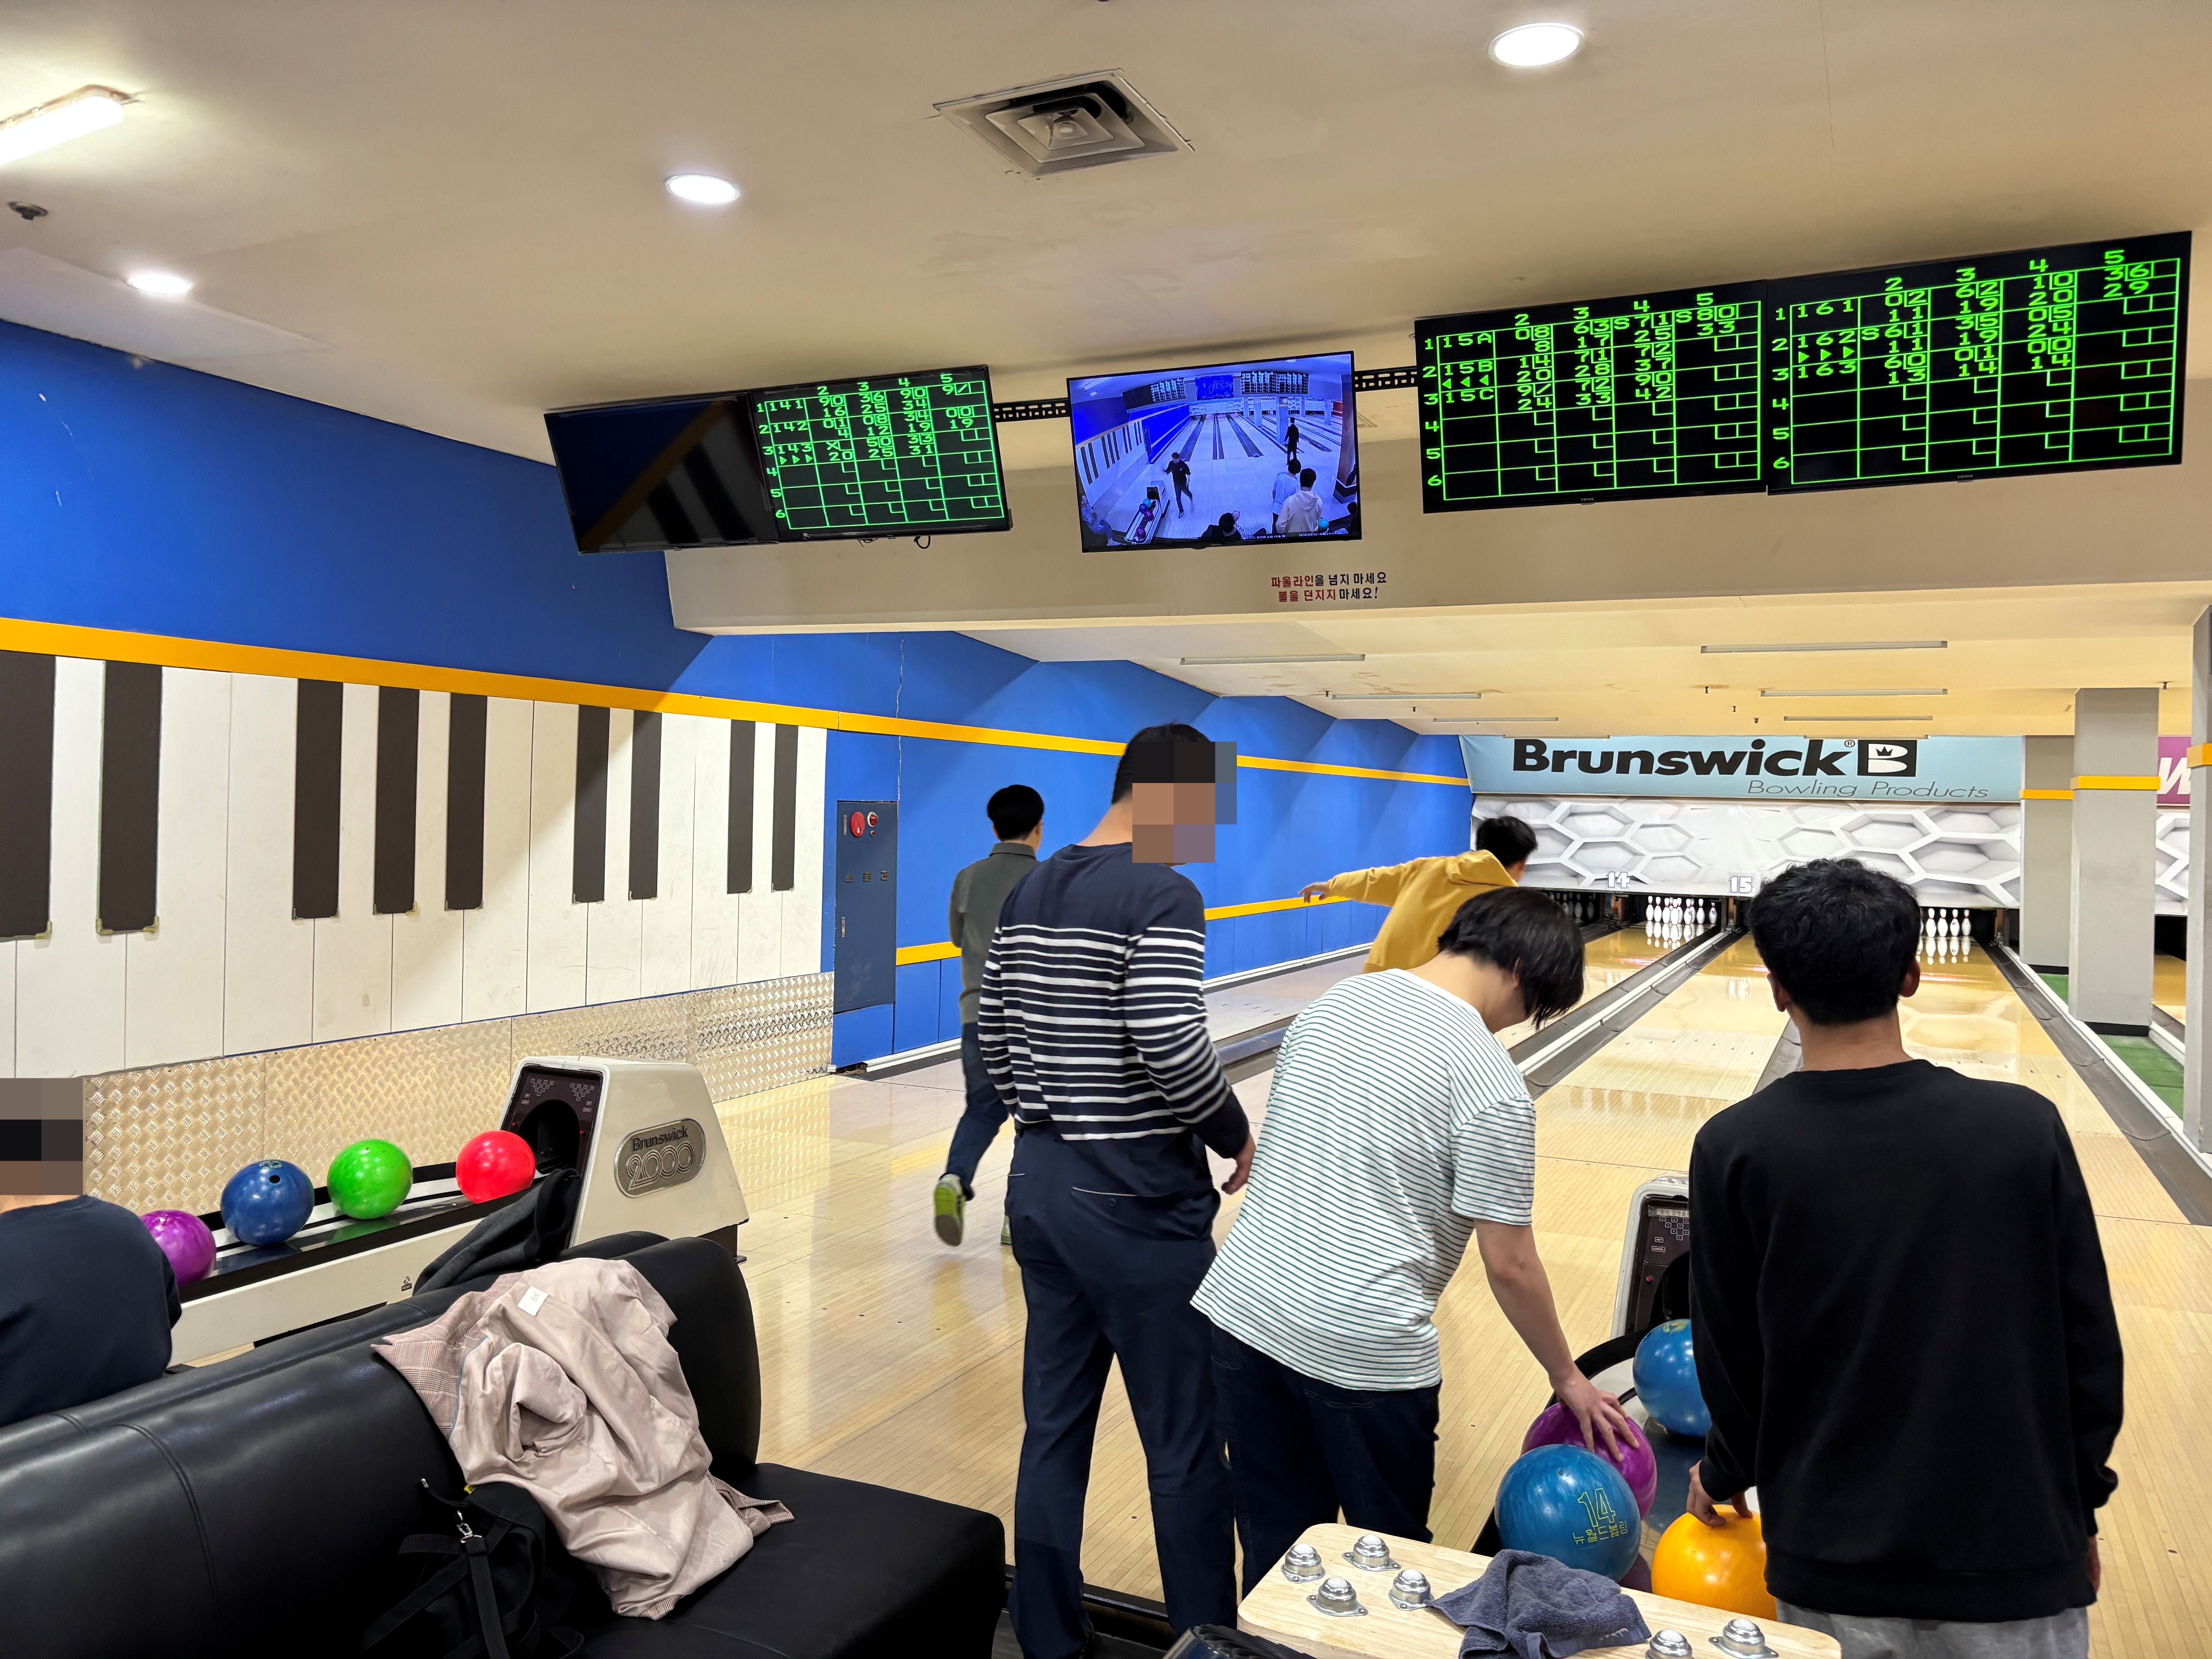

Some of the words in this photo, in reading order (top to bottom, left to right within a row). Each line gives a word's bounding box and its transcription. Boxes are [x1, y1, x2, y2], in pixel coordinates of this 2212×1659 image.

[1886, 278, 1902, 291] 2
[1957, 269, 1976, 282] 3
[2030, 259, 2048, 272] 4
[2105, 250, 2125, 263] 5
[1515, 314, 1529, 326] 2
[1573, 307, 1589, 319] 3
[1634, 300, 1649, 312] 4
[1697, 293, 1713, 306] 5
[1776, 308, 1785, 320] 1
[1425, 338, 1433, 350] 1
[1535, 340, 1550, 352] 8
[1772, 339, 1788, 350] 2
[1423, 366, 1436, 378] 2
[1772, 368, 1788, 381] 3
[817, 386, 828, 395] 2
[857, 382, 869, 391] 3
[899, 378, 910, 386] 4
[941, 374, 953, 382] 5
[1424, 393, 1438, 405] 3
[1773, 398, 1788, 410] 4
[757, 404, 764, 412] 1
[759, 426, 770, 434] 2
[1425, 421, 1438, 432] 4
[839, 429, 848, 437] 4
[1773, 428, 1789, 440] 5
[763, 447, 773, 455] 3
[828, 442, 838, 450] X
[1426, 448, 1440, 459] 5
[1774, 457, 1789, 469] 6
[767, 468, 777, 476] 4
[1428, 475, 1441, 487] 6
[1271, 575, 1324, 588] 파울라인을
[1329, 574, 1349, 586] 넘지
[1354, 572, 1387, 584] 마세요
[1278, 590, 1298, 602] 볼을
[1304, 589, 1336, 601] 던지지
[1340, 587, 1378, 599] 마세요!
[1747, 780, 1857, 797] Bowling
[1871, 781, 1989, 798] Products
[1607, 872, 1628, 888] 14
[1730, 876, 1752, 893] 15
[633, 1125, 688, 1151] Brunswick
[626, 1141, 695, 1191] 2000
[1578, 1488, 1616, 1527] 14
[1573, 1521, 1628, 1544] 뉴월드볼링
